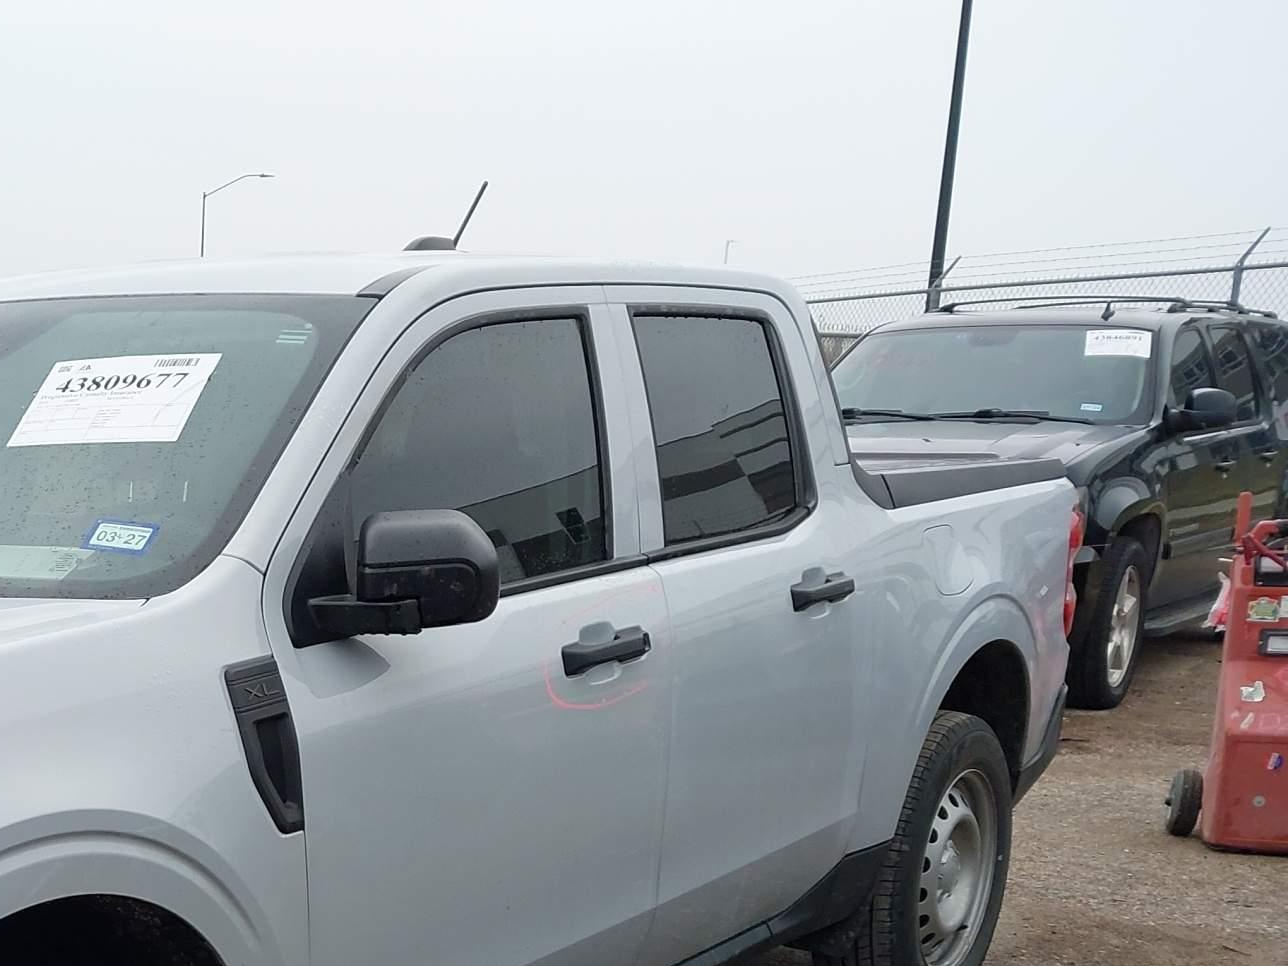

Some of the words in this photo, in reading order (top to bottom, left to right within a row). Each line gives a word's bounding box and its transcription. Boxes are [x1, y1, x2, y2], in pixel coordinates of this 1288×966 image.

[55, 373, 190, 393] 43809677
[96, 530, 118, 543] 03
[123, 533, 147, 546] 27
[244, 684, 280, 700] XL
